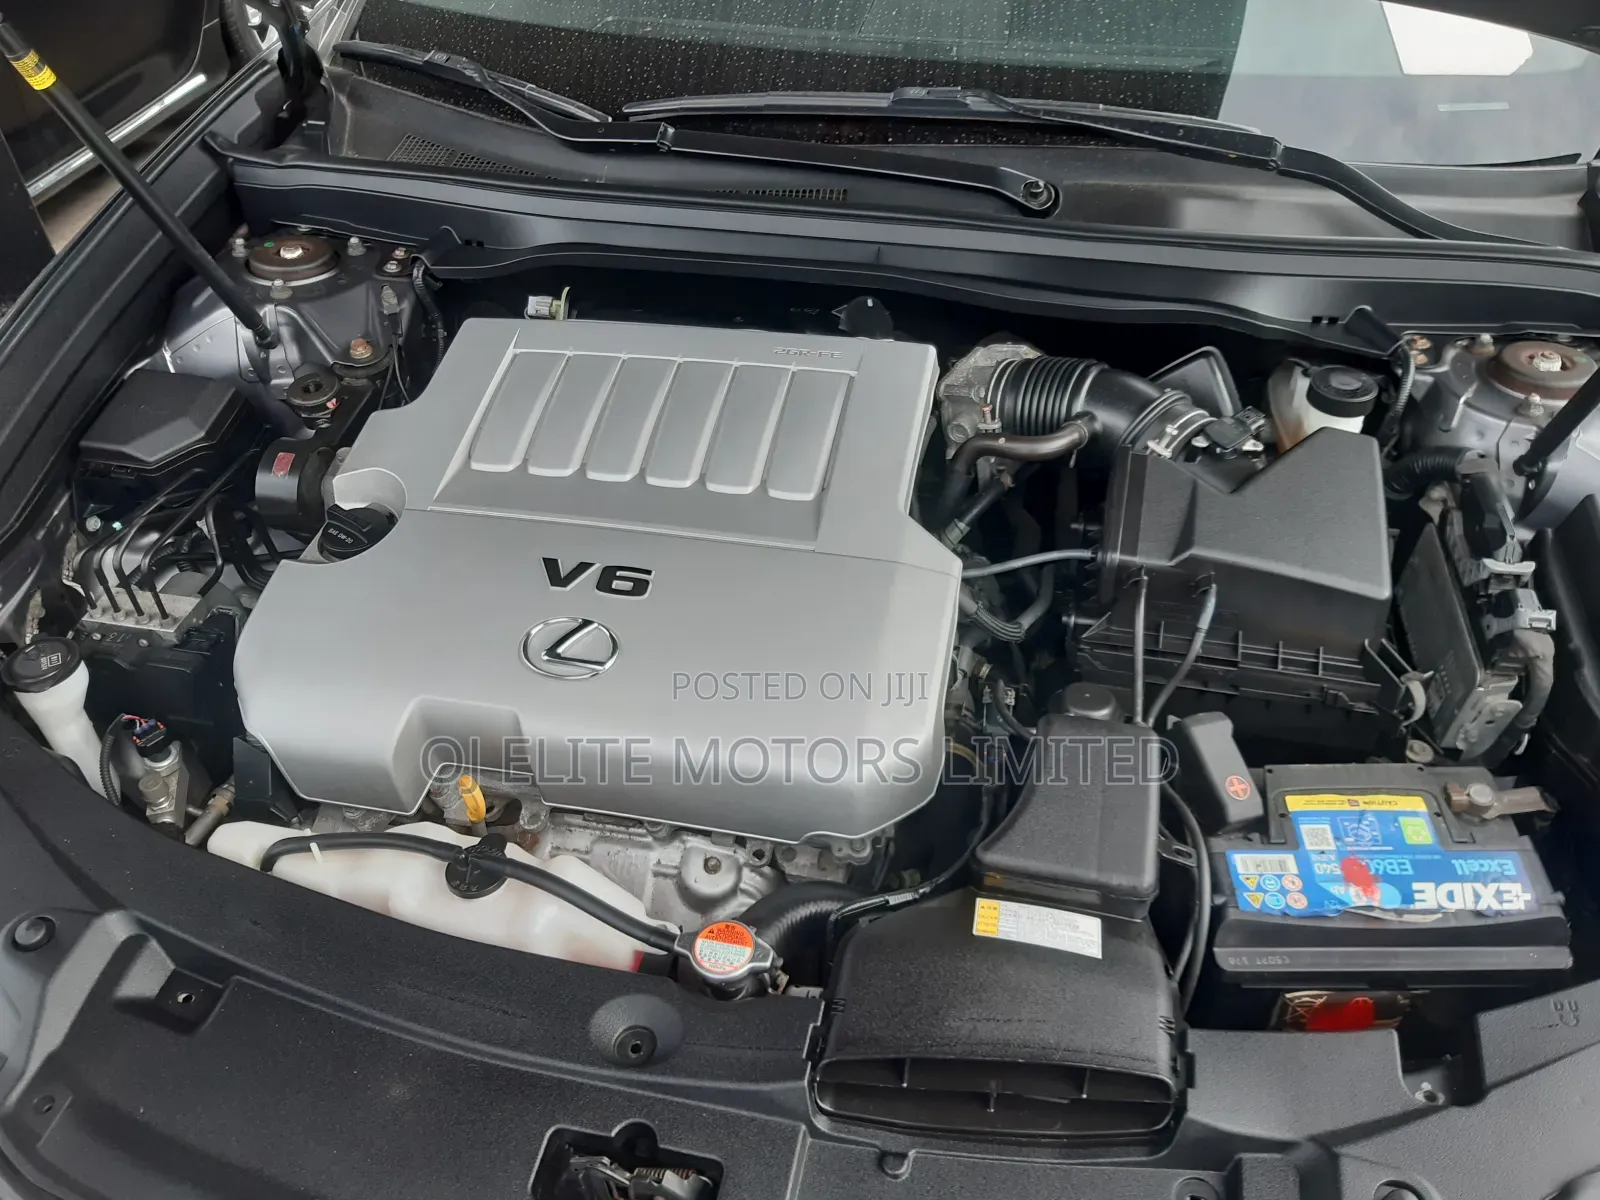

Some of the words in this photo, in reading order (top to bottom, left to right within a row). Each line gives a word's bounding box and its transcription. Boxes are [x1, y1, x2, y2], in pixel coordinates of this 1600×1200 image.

[773, 347, 842, 359] 2GR-FE
[541, 556, 655, 600] V6
[1315, 863, 1342, 875] 540
[1451, 859, 1517, 876] Excell
[1411, 882, 1531, 910] EXIDE
